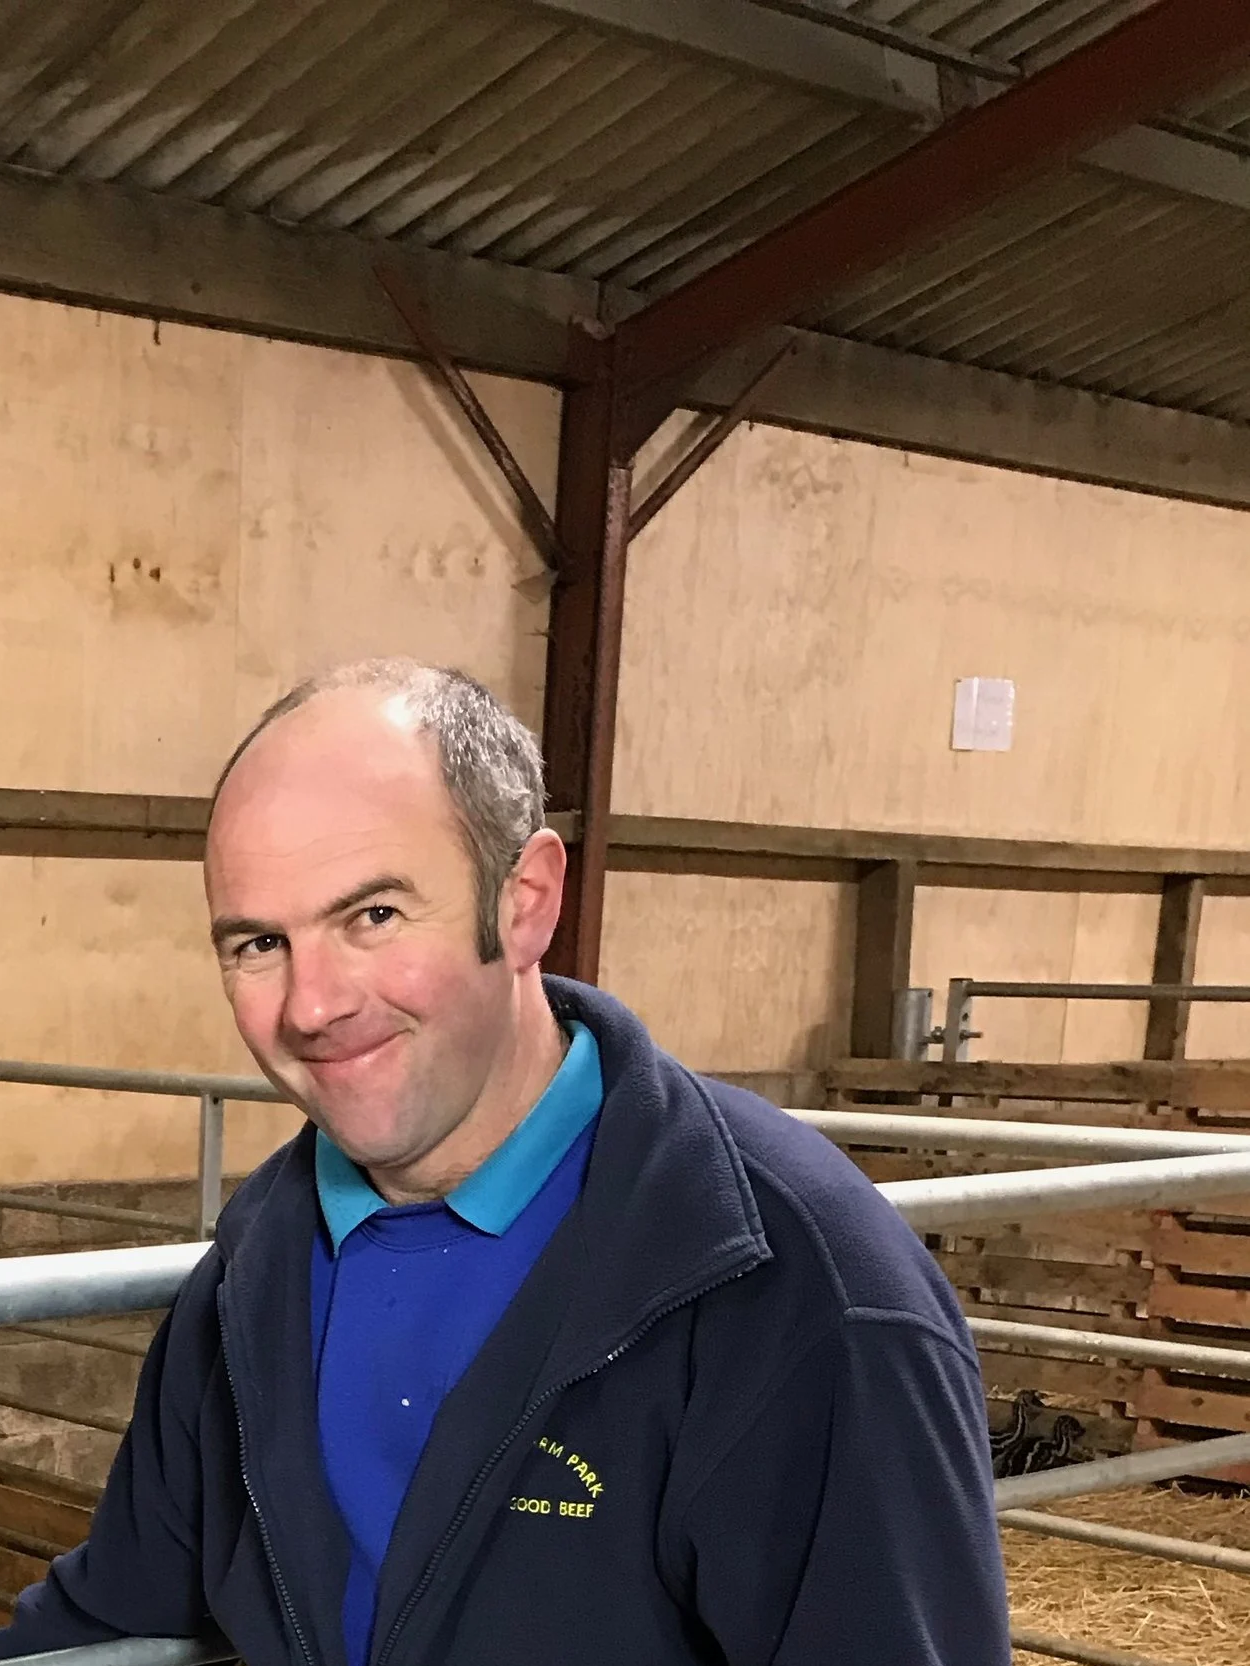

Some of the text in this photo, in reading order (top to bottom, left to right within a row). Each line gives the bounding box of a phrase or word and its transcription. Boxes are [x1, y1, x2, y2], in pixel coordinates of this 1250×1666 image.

[536, 1437, 604, 1498] RM PARK
[559, 1501, 594, 1518] BEEF
